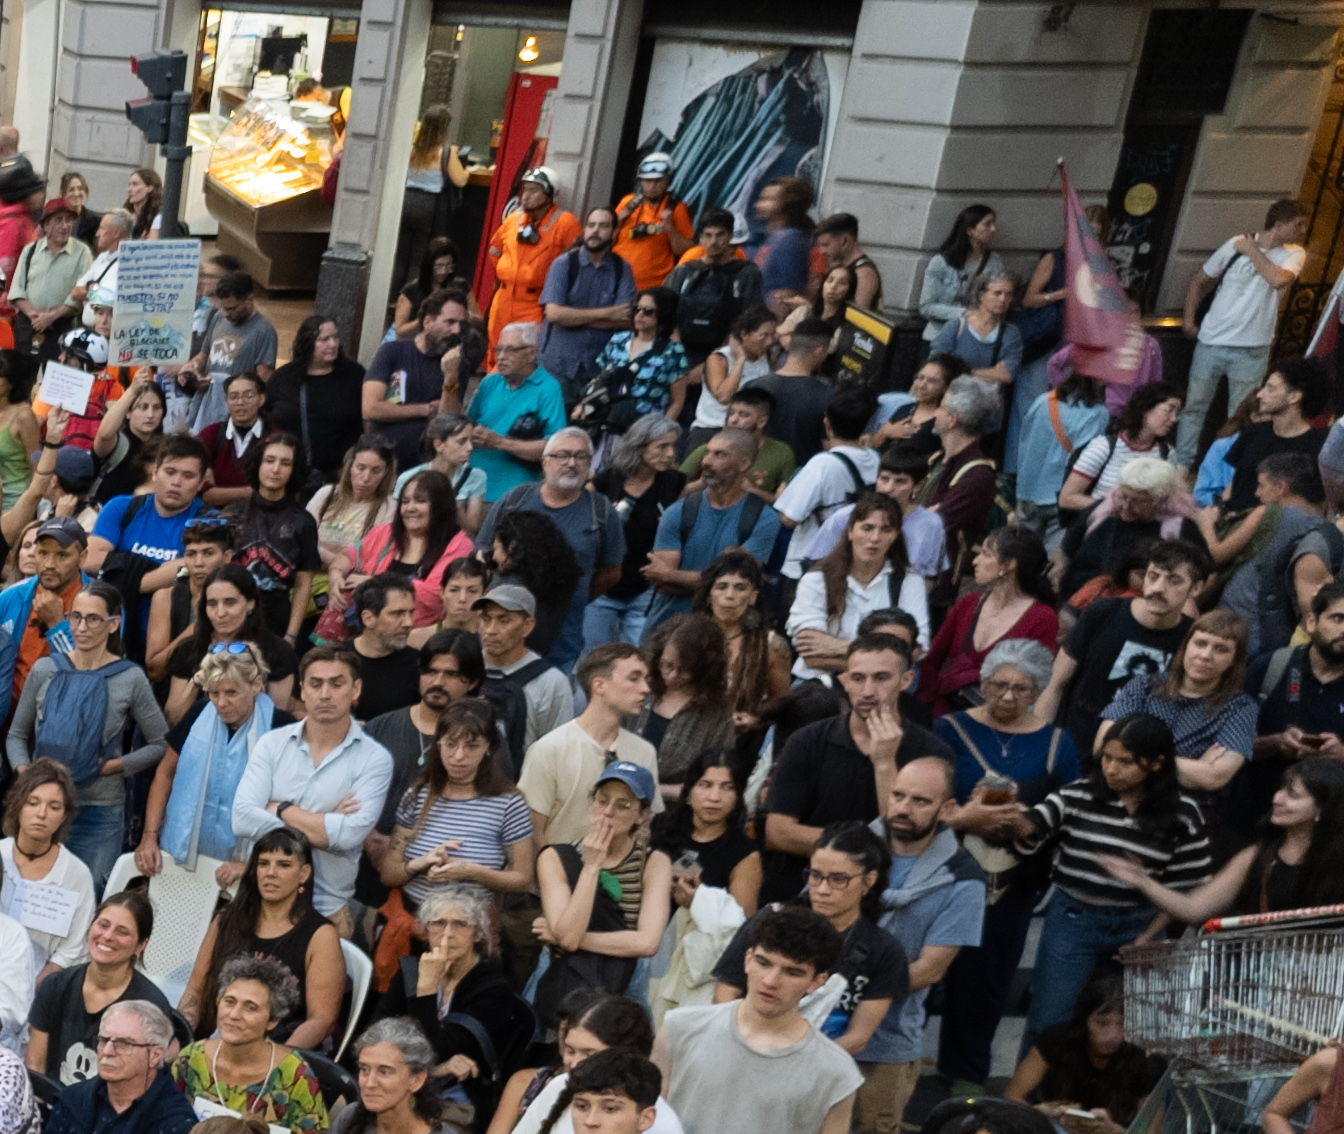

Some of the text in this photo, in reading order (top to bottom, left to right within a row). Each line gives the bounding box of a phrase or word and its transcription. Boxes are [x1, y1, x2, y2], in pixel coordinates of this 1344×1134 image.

[114, 329, 126, 339] LA
[118, 348, 178, 360] NO SE TOCA
[131, 542, 178, 561] LACOST
